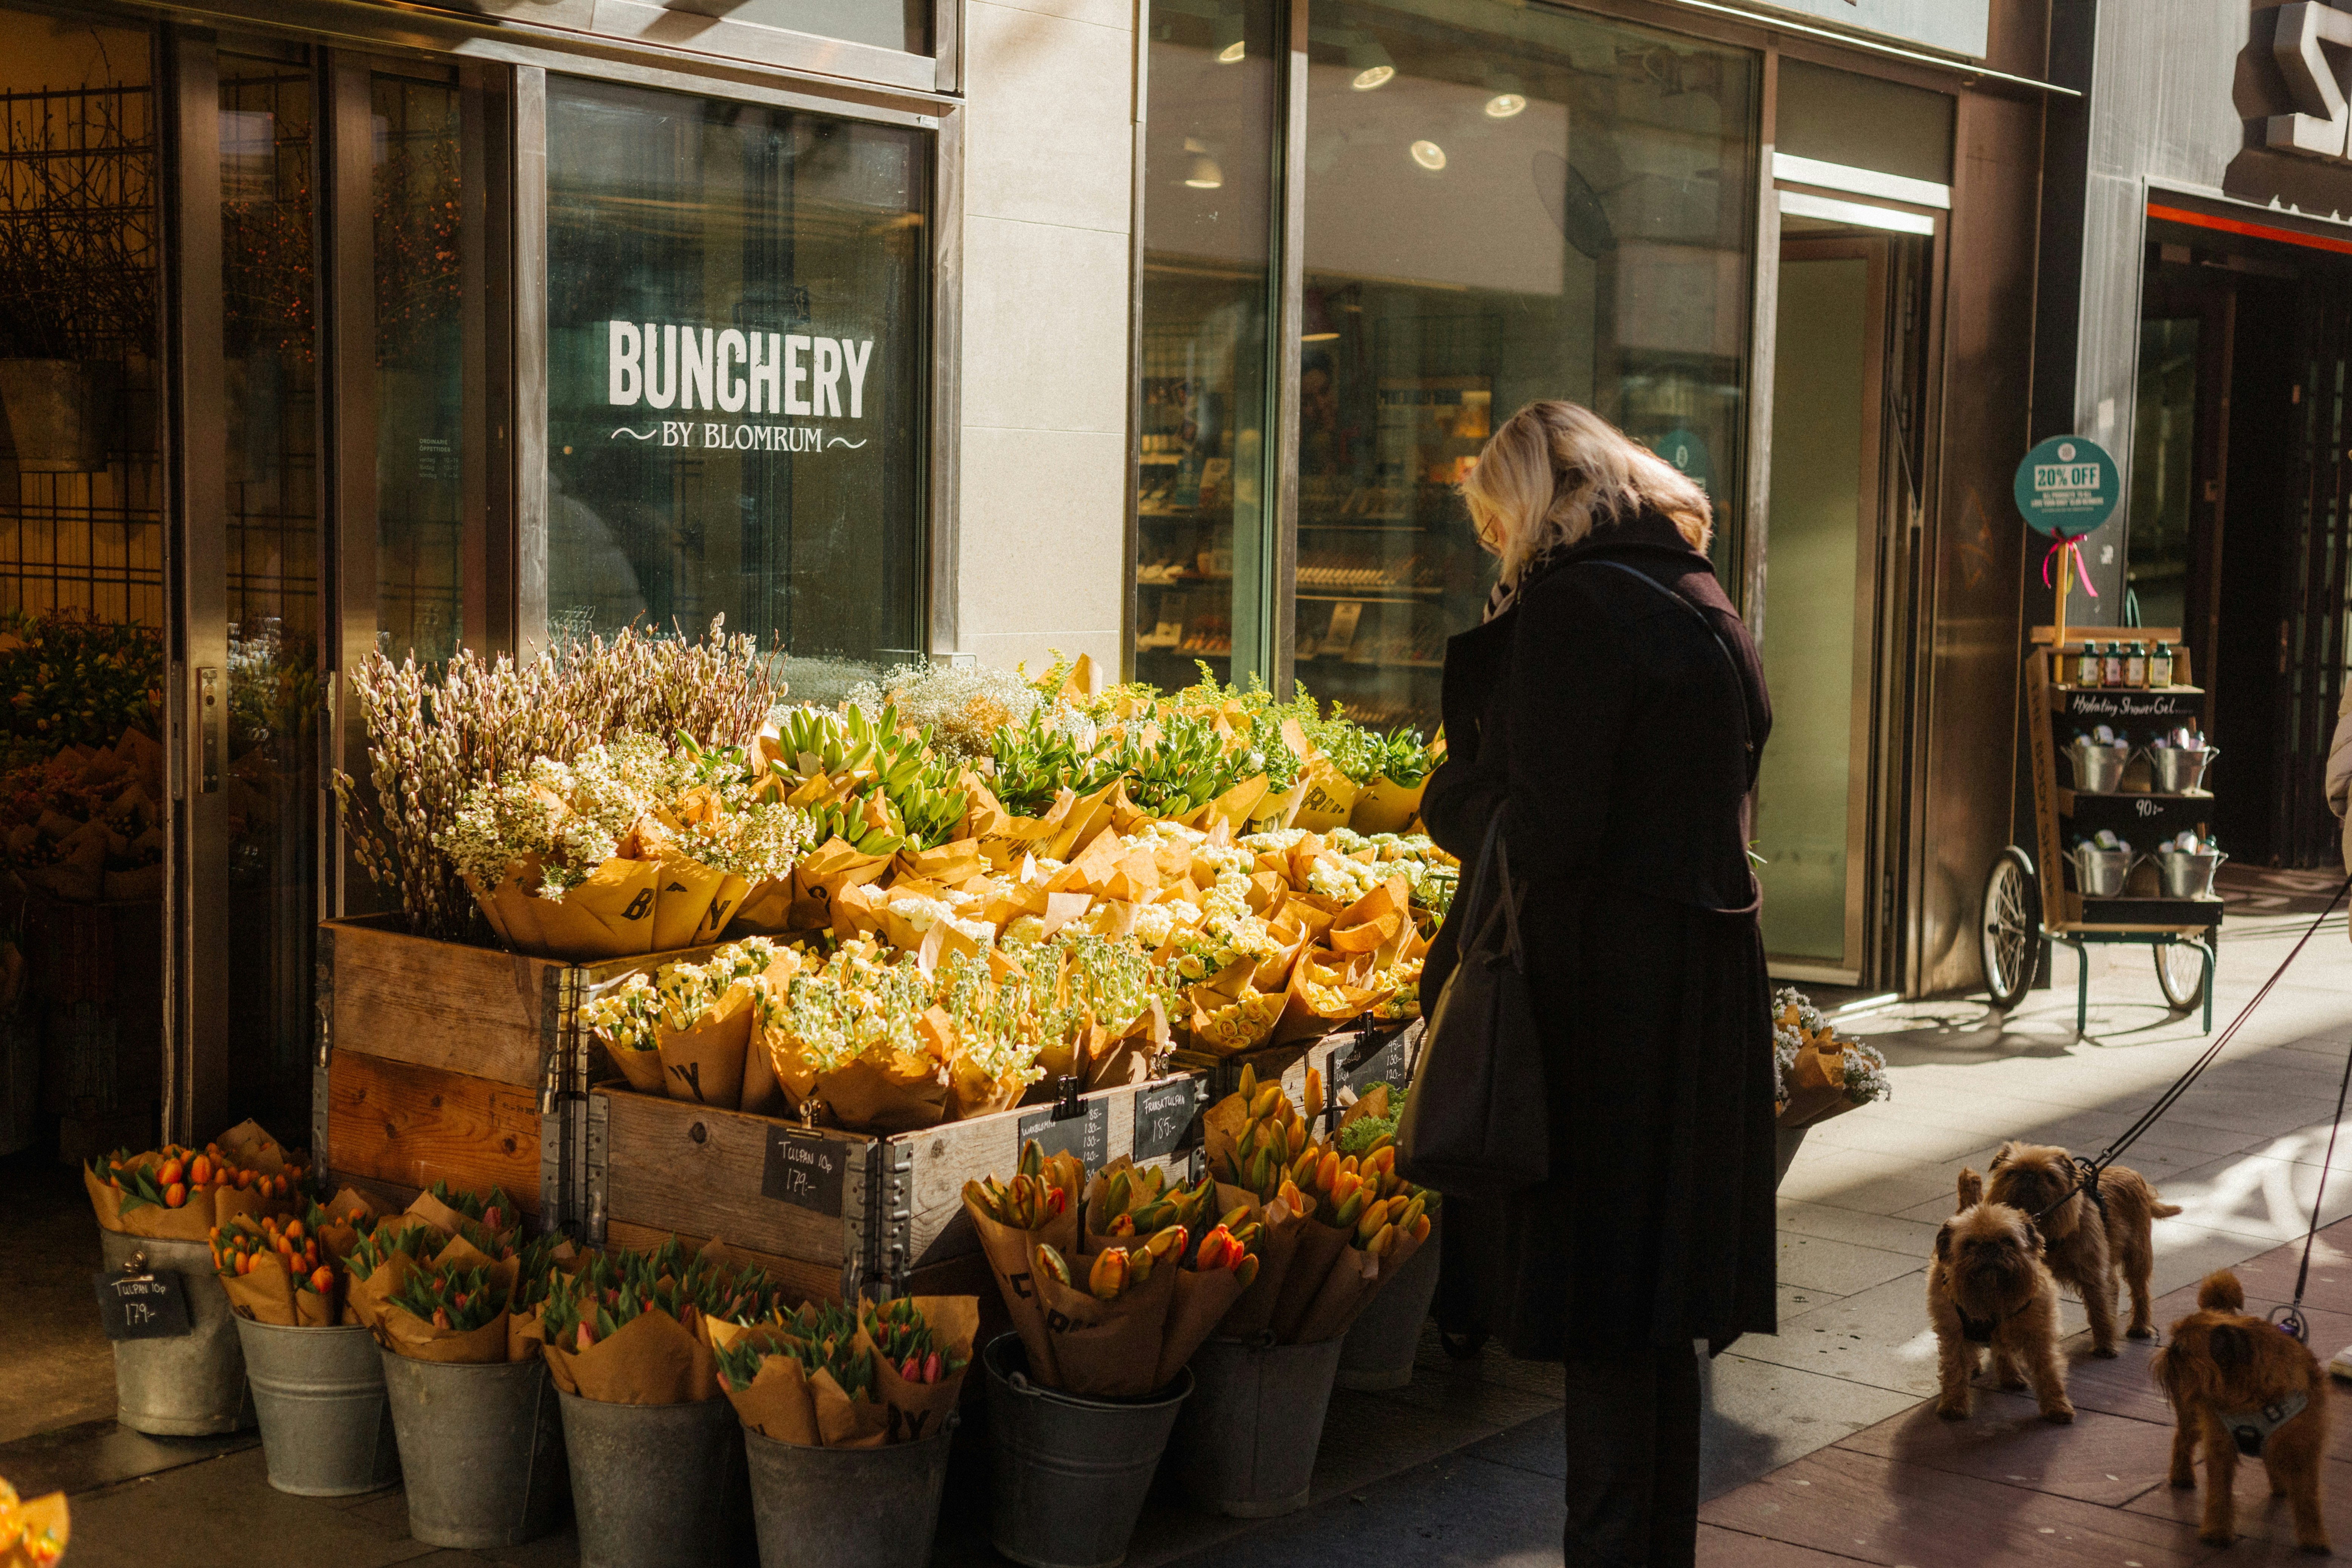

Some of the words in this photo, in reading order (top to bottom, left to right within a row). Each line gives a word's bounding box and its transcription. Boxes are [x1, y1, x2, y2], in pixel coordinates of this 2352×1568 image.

[609, 320, 873, 418] BUNCHERY
[662, 421, 694, 447] BY
[703, 423, 822, 452] BLOMRUM
[2038, 468, 2068, 487] 20%
[2072, 467, 2097, 485] OFF
[778, 1141, 814, 1164] TULPAN
[111, 1281, 148, 1297] TULPAN
